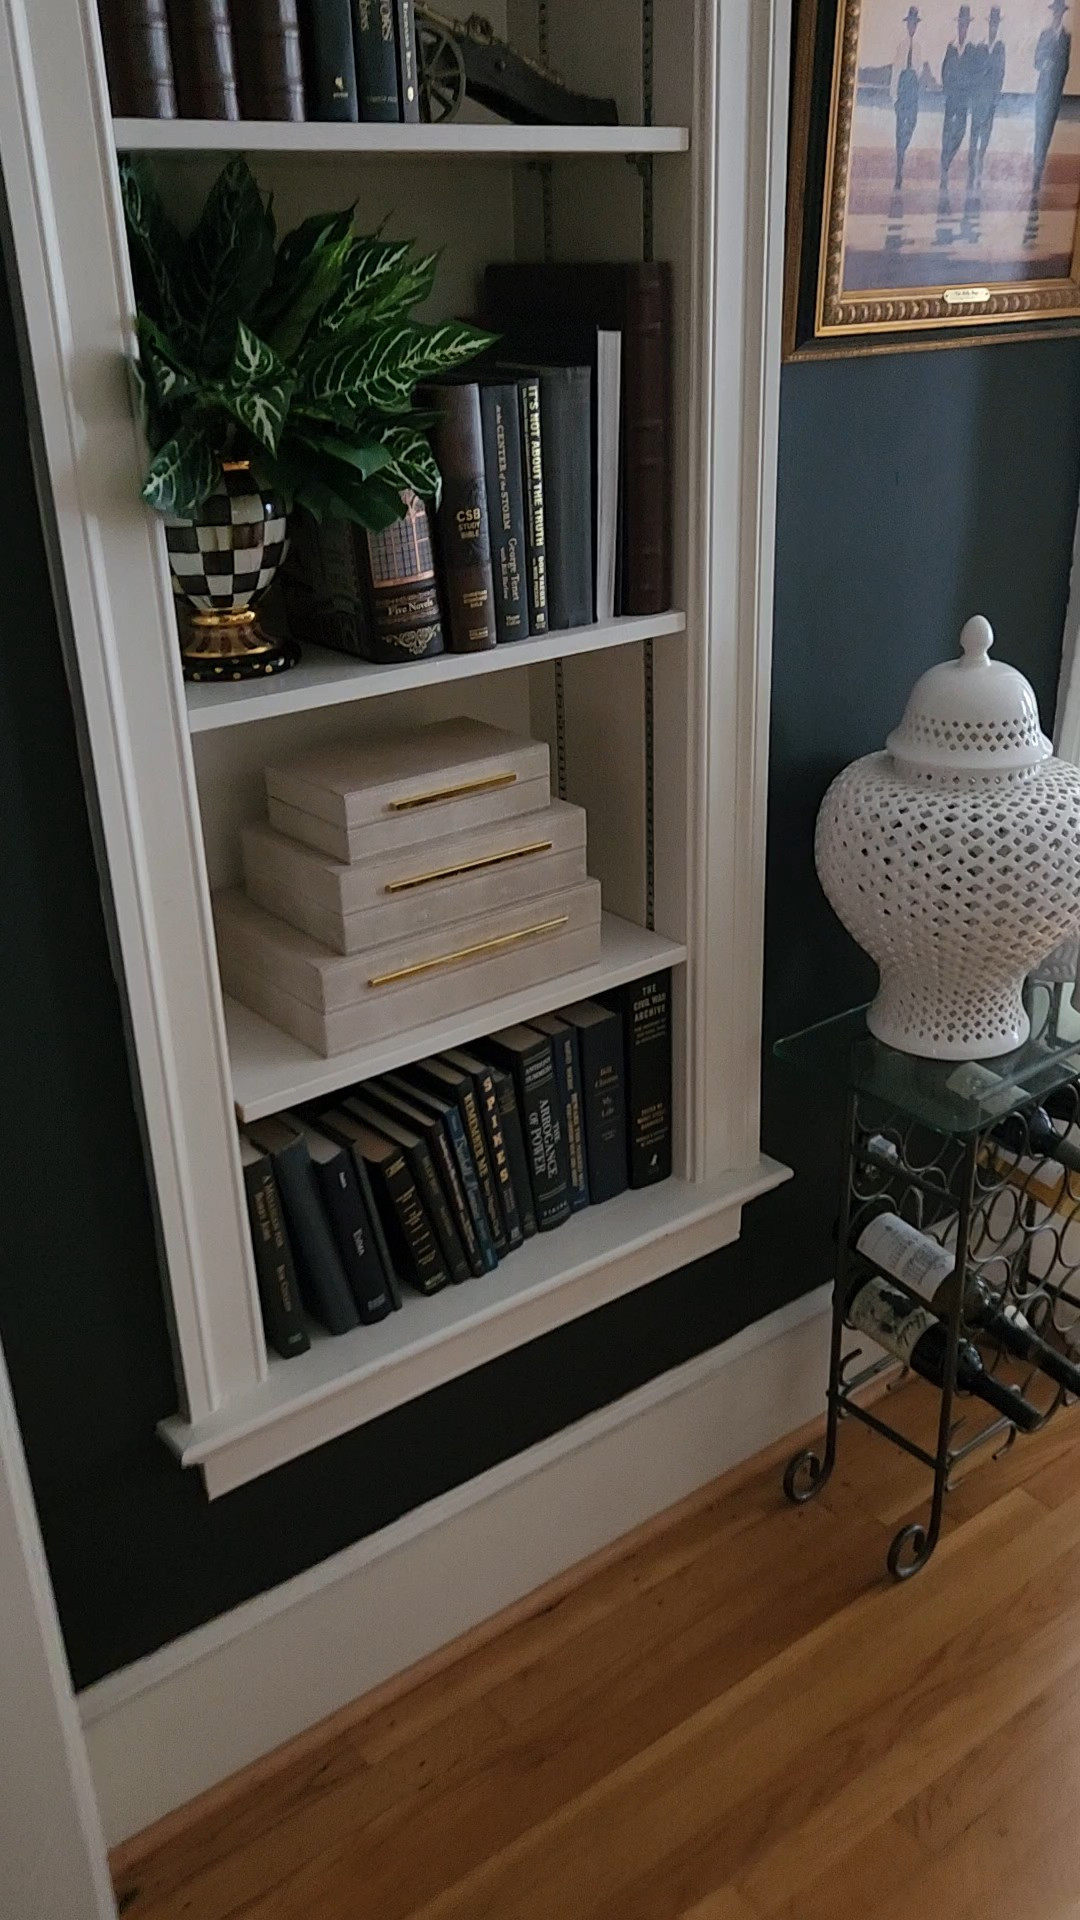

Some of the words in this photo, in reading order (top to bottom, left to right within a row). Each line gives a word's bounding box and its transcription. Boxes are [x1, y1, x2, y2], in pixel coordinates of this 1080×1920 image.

[528, 385, 539, 411] IT'S
[530, 412, 541, 437] NOT
[496, 425, 507, 472] CENTER
[531, 440, 542, 481] ABOUT
[533, 481, 544, 507] THE
[456, 507, 481, 522] CSB
[501, 491, 511, 530] STORM
[458, 521, 481, 532] STUDY
[534, 507, 545, 548] TRUTH
[508, 537, 518, 573] George
[511, 573, 520, 601] Tenet
[387, 605, 408, 616] Five
[408, 597, 434, 613] Novels
[633, 996, 651, 1012] CIVIL
[652, 992, 667, 1007] WAR
[641, 983, 657, 996] THE
[634, 1005, 666, 1023] ARCHIVE
[529, 1112, 538, 1127] OF
[553, 1121, 561, 1142] THE
[464, 1092, 484, 1160] REMEMBER
[476, 1155, 488, 1178] ME
[539, 1099, 559, 1179] ARROGANCE
[530, 1126, 546, 1176] POWER
